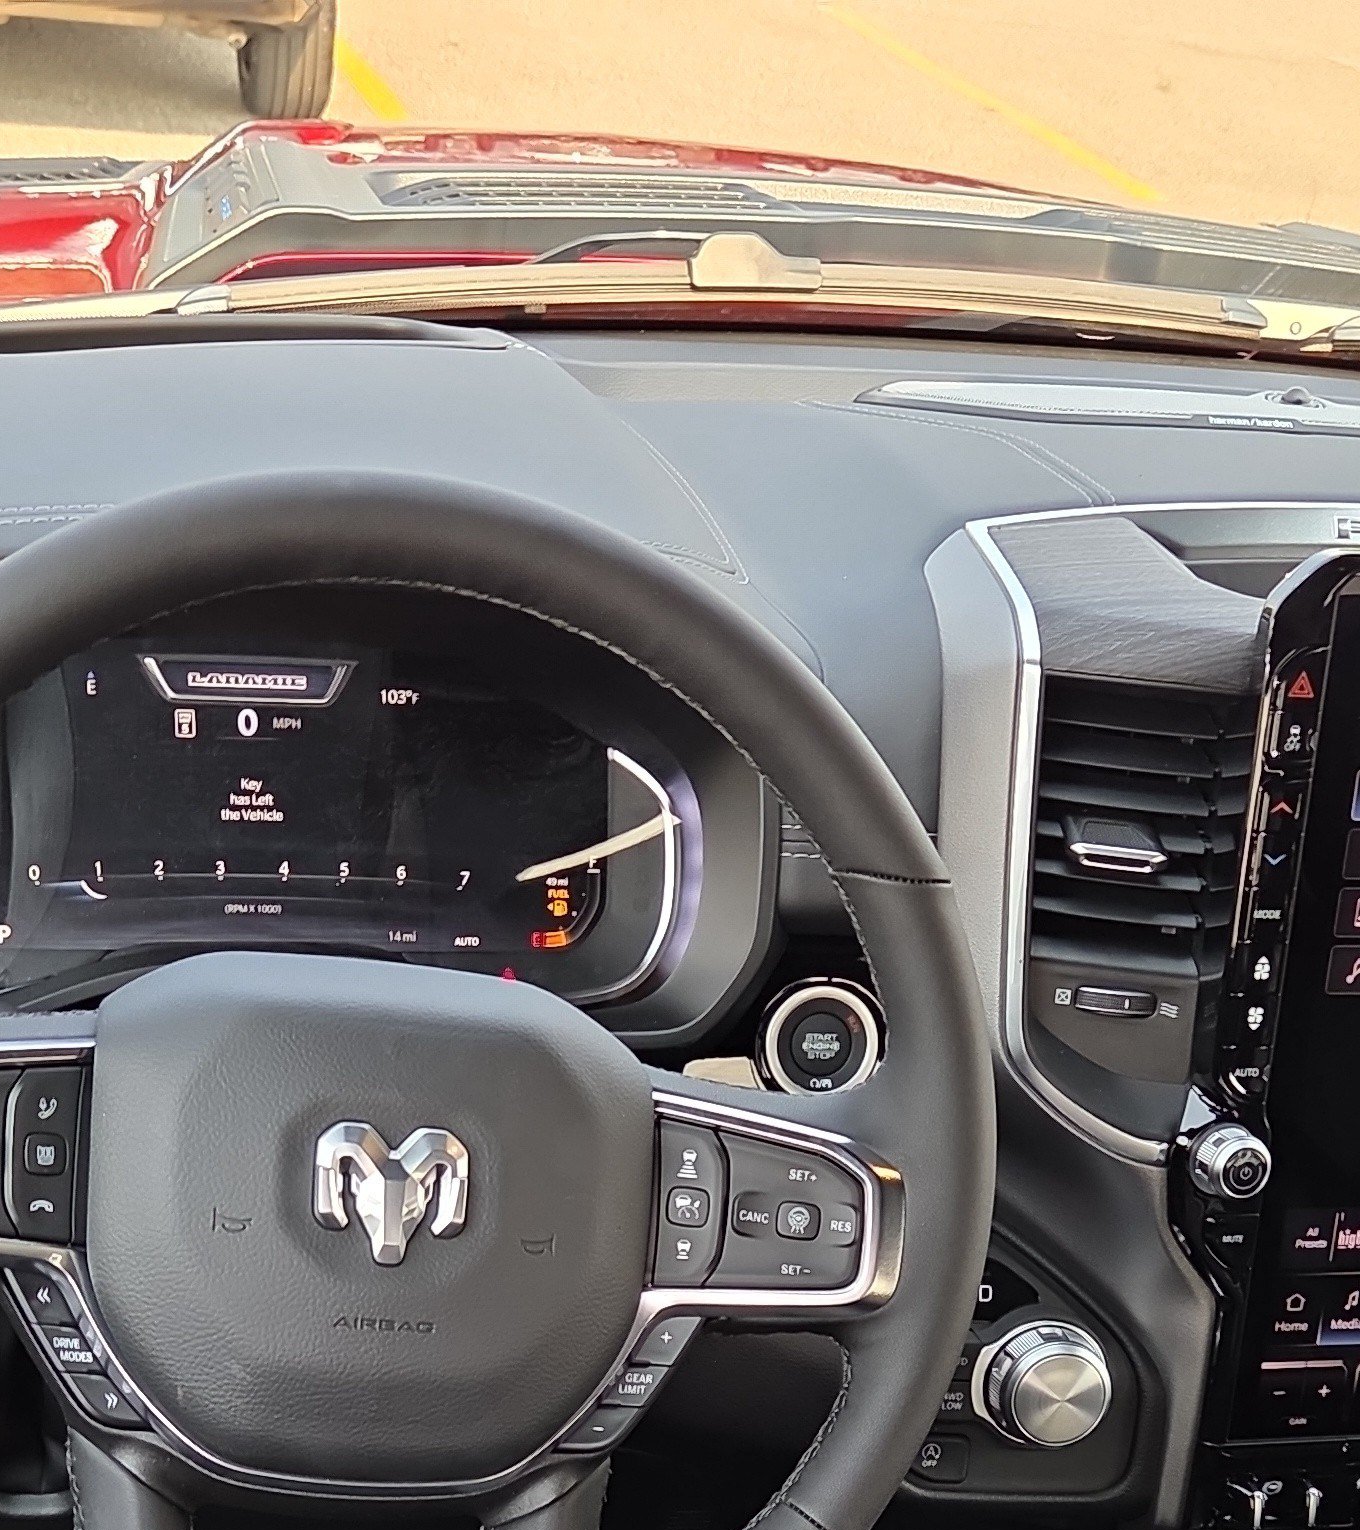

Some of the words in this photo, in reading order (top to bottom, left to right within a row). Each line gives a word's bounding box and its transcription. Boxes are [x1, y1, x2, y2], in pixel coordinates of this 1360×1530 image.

[187, 671, 308, 691] LARAMIE
[379, 688, 421, 706] 103°F
[237, 708, 259, 738] 0
[271, 716, 302, 731] MPH
[240, 777, 262, 793] Key
[229, 793, 251, 807] has
[251, 793, 275, 807] Left
[221, 808, 241, 822] the
[242, 808, 284, 822] Vehicle
[28, 864, 40, 881] 0
[94, 860, 103, 876] 1
[153, 859, 165, 876] 2
[215, 859, 226, 876] 3
[278, 860, 290, 877] 4
[340, 861, 350, 877] 5
[395, 865, 407, 880] 6
[459, 870, 470, 887] 7
[546, 888, 570, 899] FUEL
[453, 935, 481, 948] AUTO
[804, 1032, 839, 1042] START
[806, 1051, 836, 1060] STOP
[1233, 1067, 1261, 1078] AUTO
[738, 1209, 770, 1225] CANC
[829, 1220, 853, 1233] RES
[332, 1315, 436, 1334] AIRBAG
[1274, 1320, 1309, 1333] Home
[52, 1336, 81, 1349] DRIVE
[60, 1350, 94, 1363] MODES
[624, 1372, 654, 1384] GEAR
[618, 1383, 648, 1395] LIMIT
[941, 1401, 963, 1411] LOW
